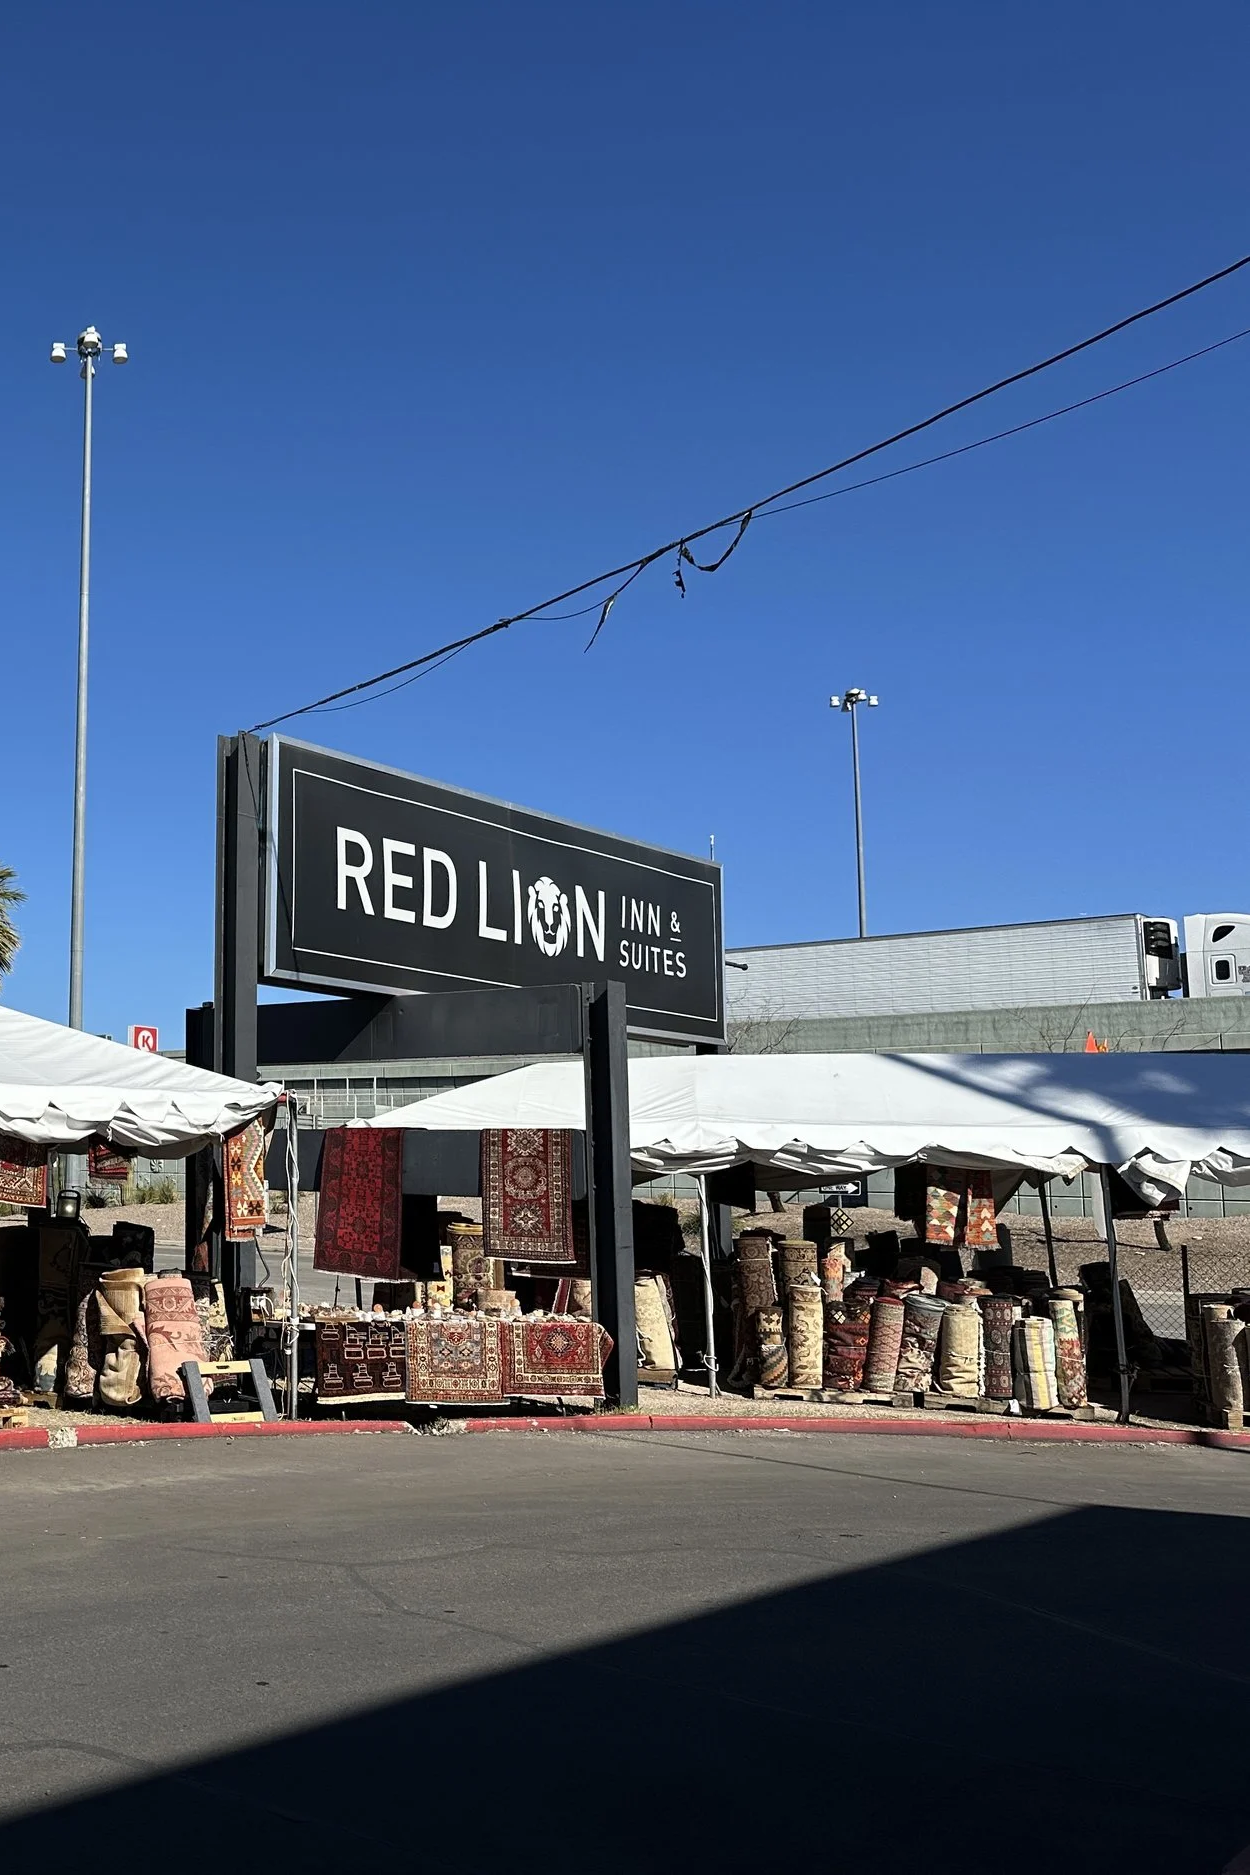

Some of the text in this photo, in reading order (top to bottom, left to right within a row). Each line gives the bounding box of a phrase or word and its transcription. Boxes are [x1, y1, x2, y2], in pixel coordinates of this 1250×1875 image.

[336, 825, 458, 930] RED
[621, 895, 682, 943] INN &
[619, 939, 688, 979] SUITES
[142, 1035, 152, 1051] K
